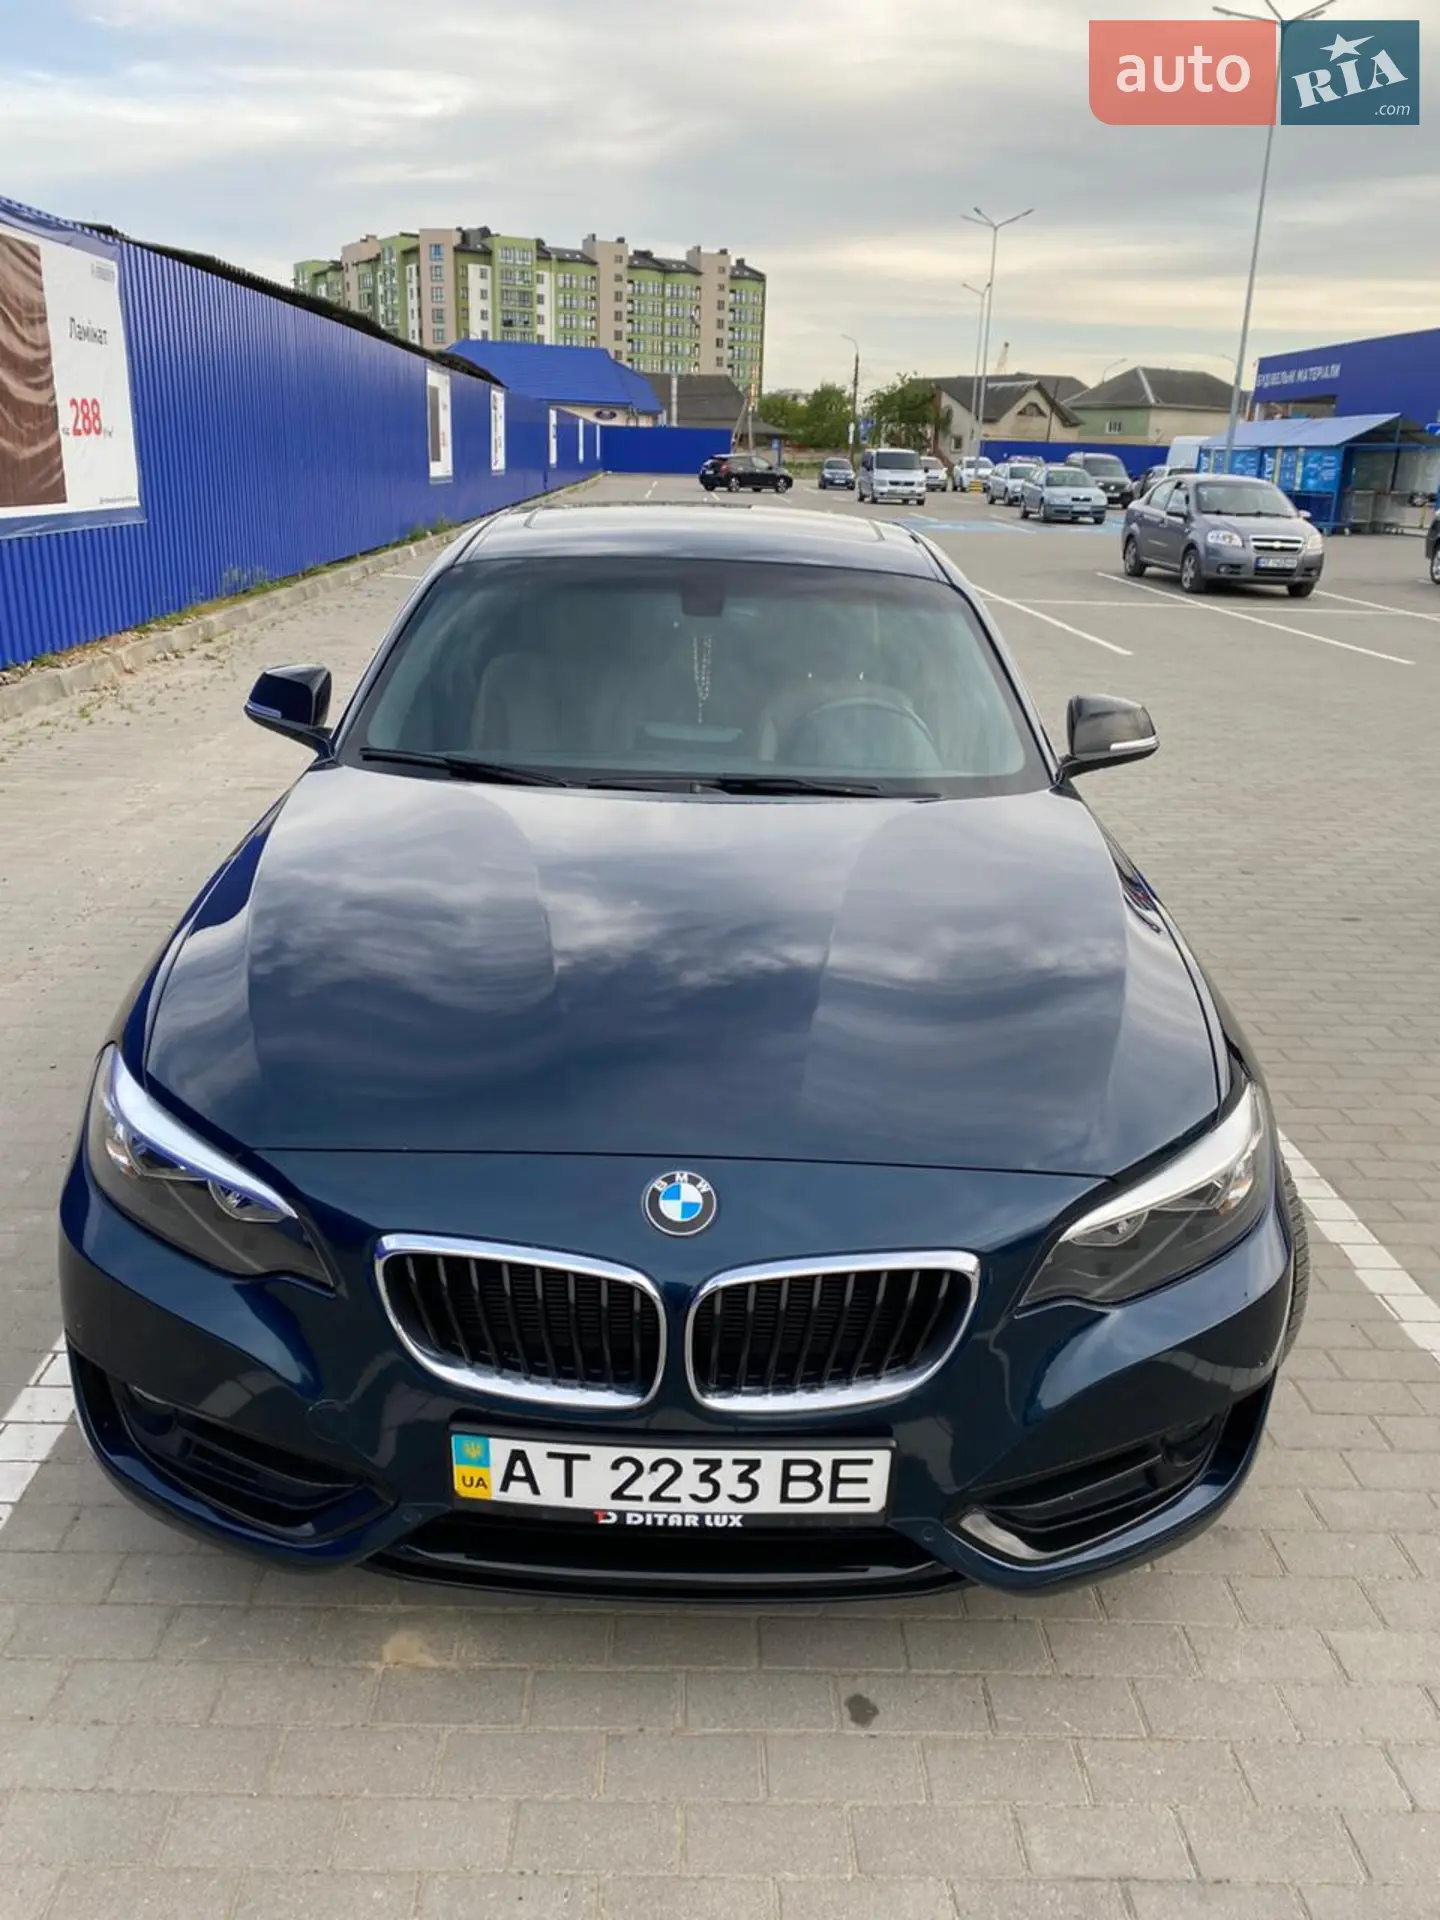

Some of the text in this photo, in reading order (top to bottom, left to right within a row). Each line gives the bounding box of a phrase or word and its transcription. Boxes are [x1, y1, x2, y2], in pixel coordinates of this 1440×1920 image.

[70, 397, 102, 435] 288
[653, 1171, 712, 1194] BMW
[461, 1474, 488, 1490] UA
[499, 1448, 874, 1504] AT 2233 BE
[626, 1512, 700, 1527] DITAR
[705, 1514, 744, 1527] LUX
